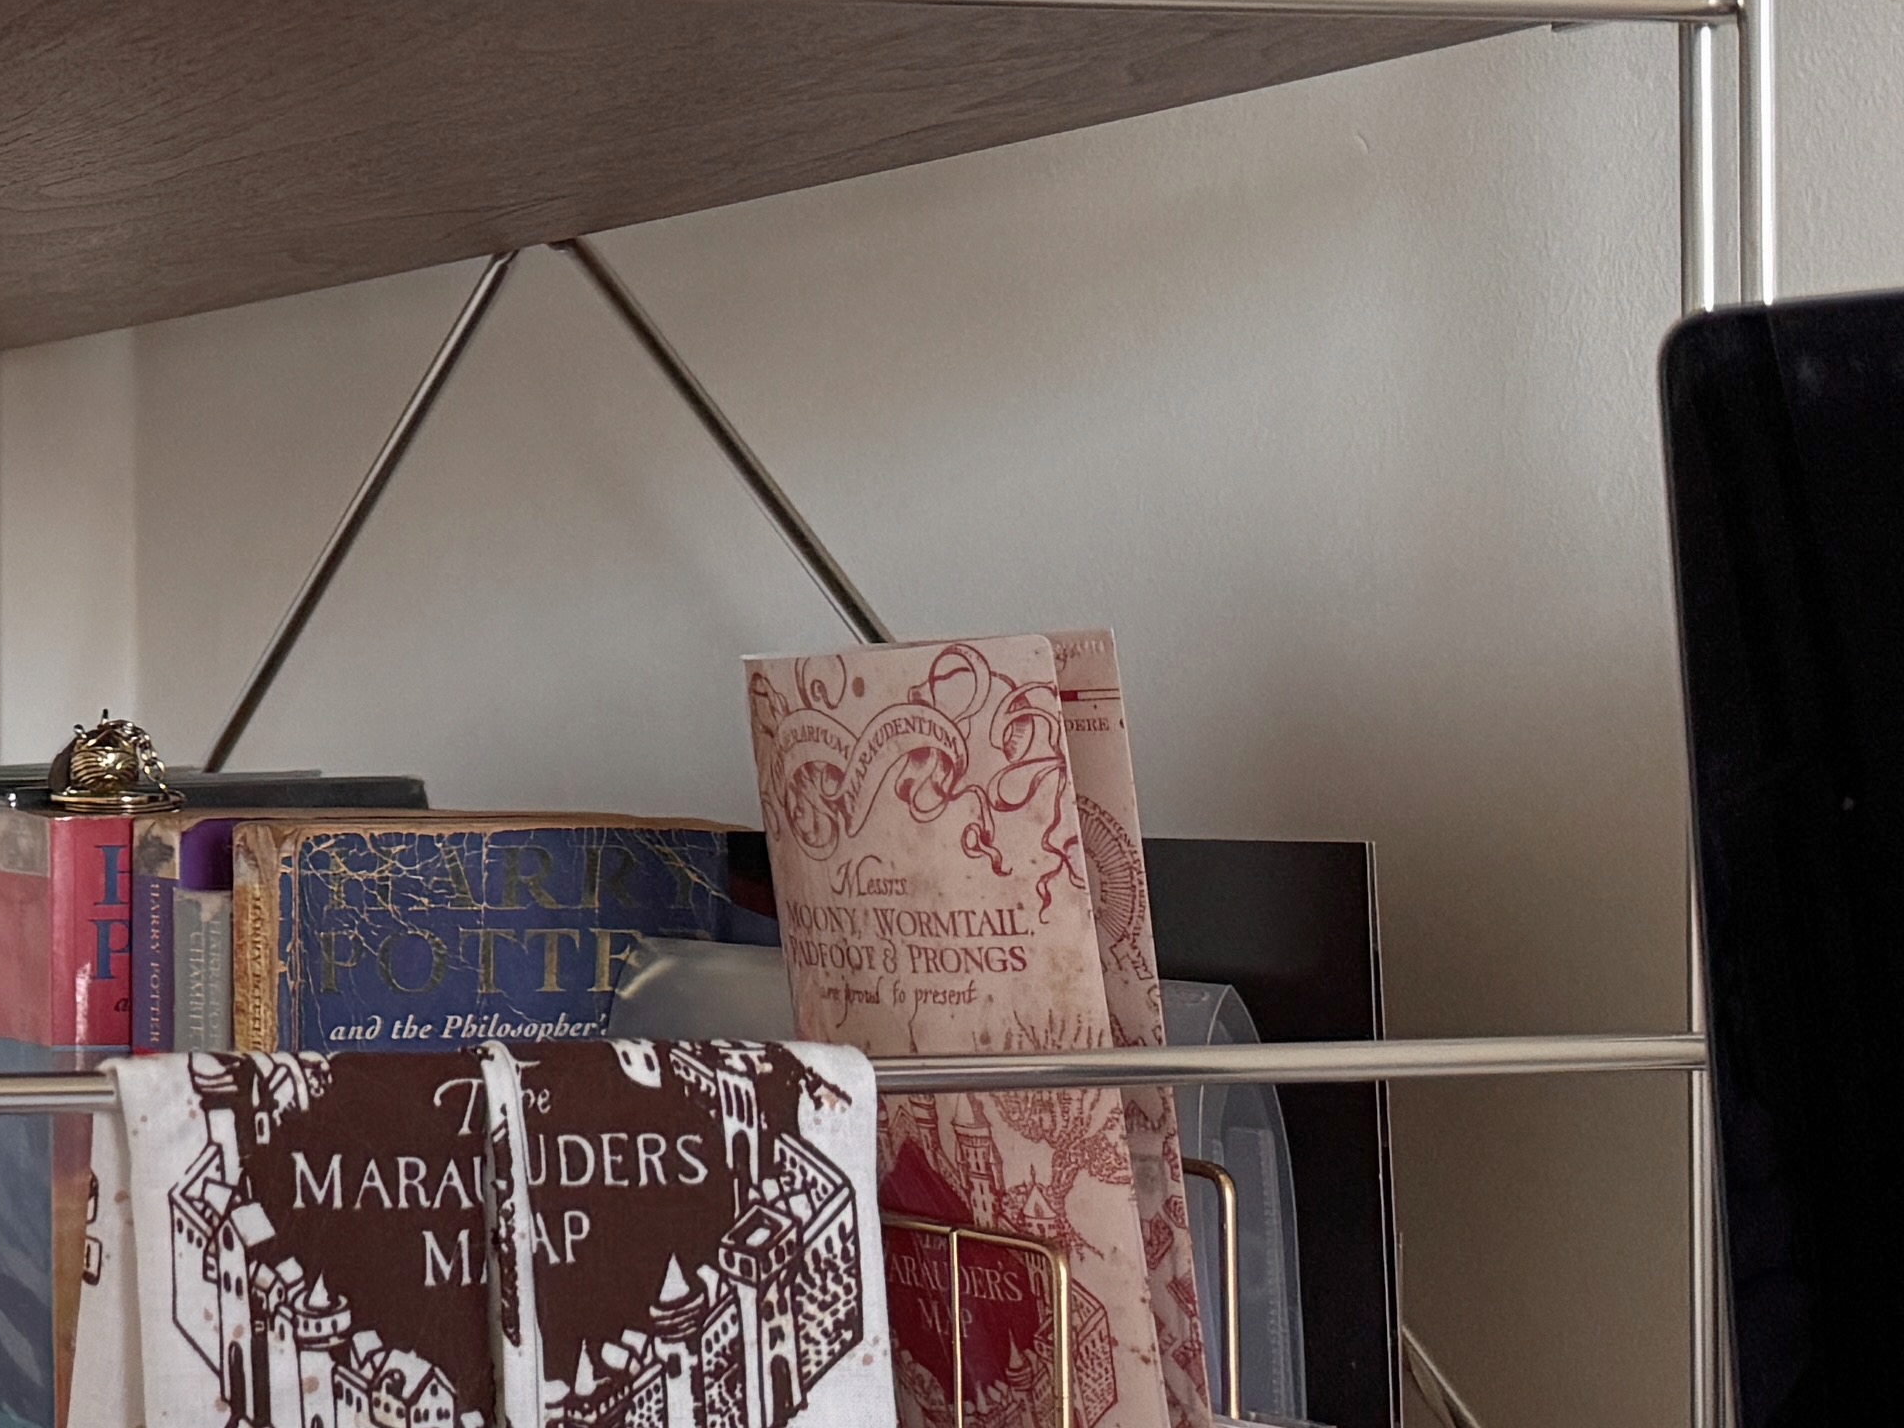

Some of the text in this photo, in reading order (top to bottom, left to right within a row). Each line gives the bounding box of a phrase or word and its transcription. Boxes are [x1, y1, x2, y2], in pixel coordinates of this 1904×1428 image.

[322, 845, 715, 910] HARRY
[149, 882, 161, 1043] HARRY POTTER
[908, 945, 1028, 974] PRONGS
[330, 1012, 607, 1043] and the Philosopher'
